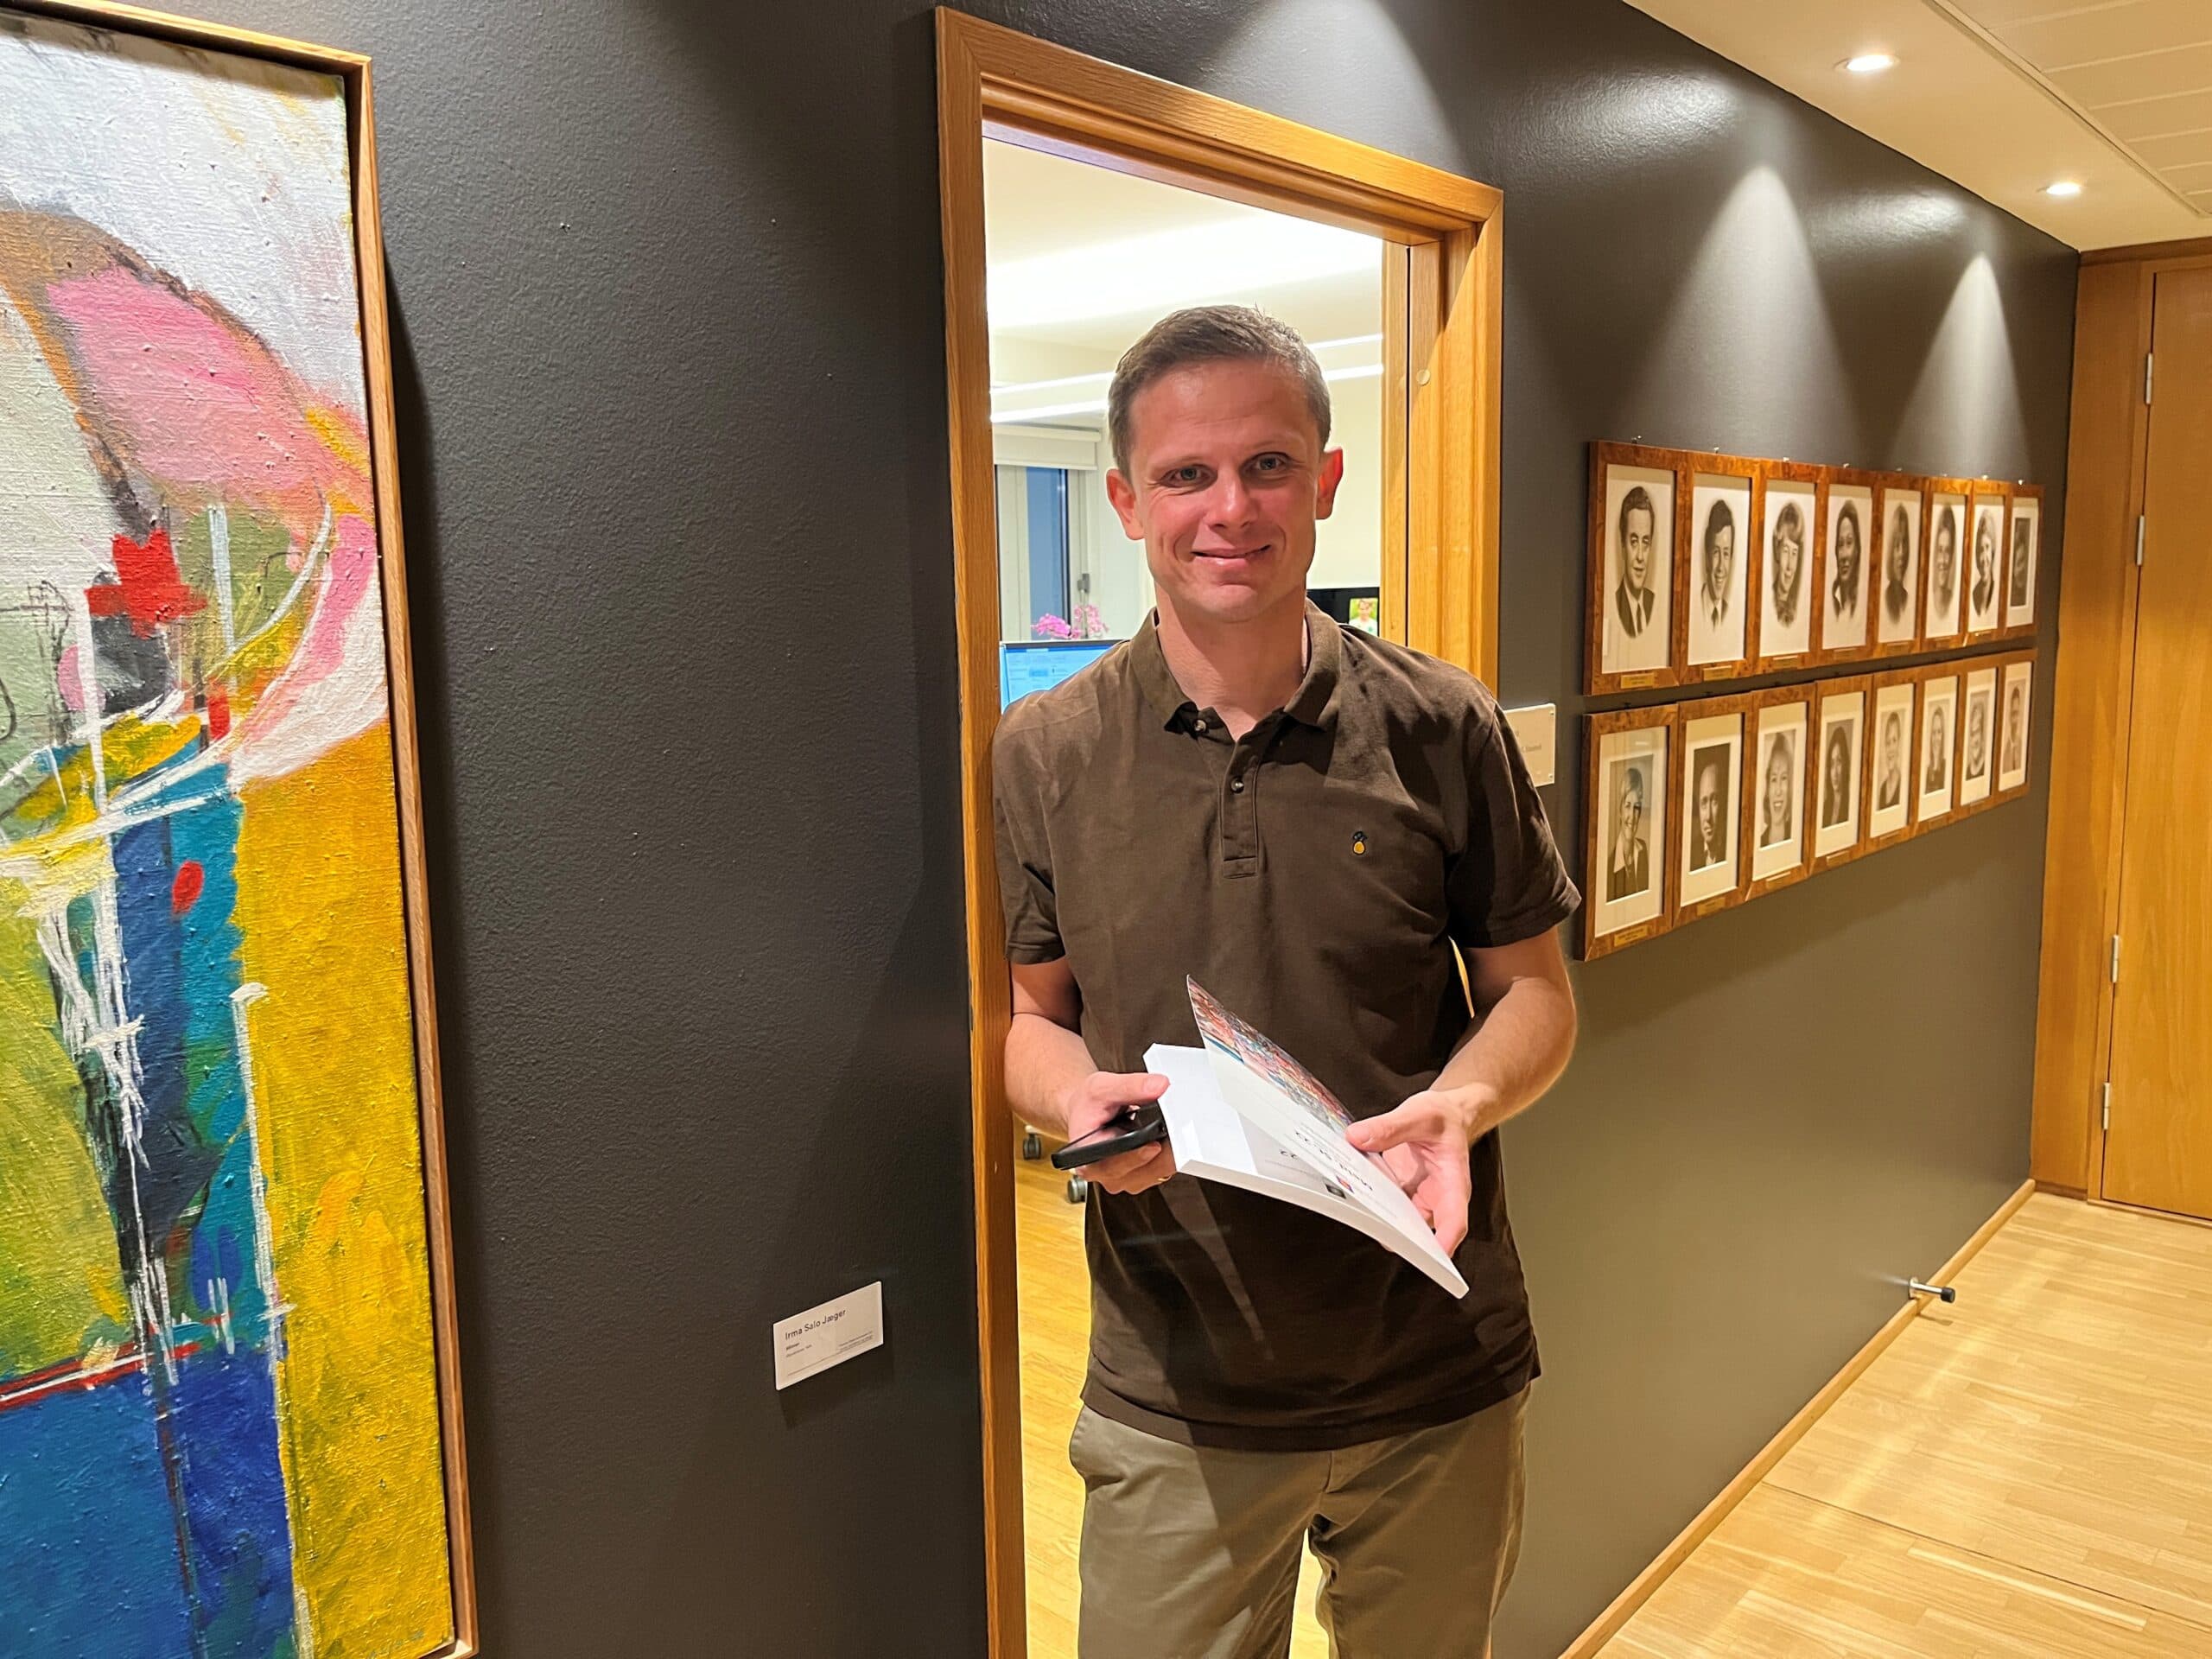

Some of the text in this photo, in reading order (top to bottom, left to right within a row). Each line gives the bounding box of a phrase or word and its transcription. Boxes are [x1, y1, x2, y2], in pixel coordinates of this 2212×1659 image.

[785, 1309, 846, 1340] Irma Salo Jæger
